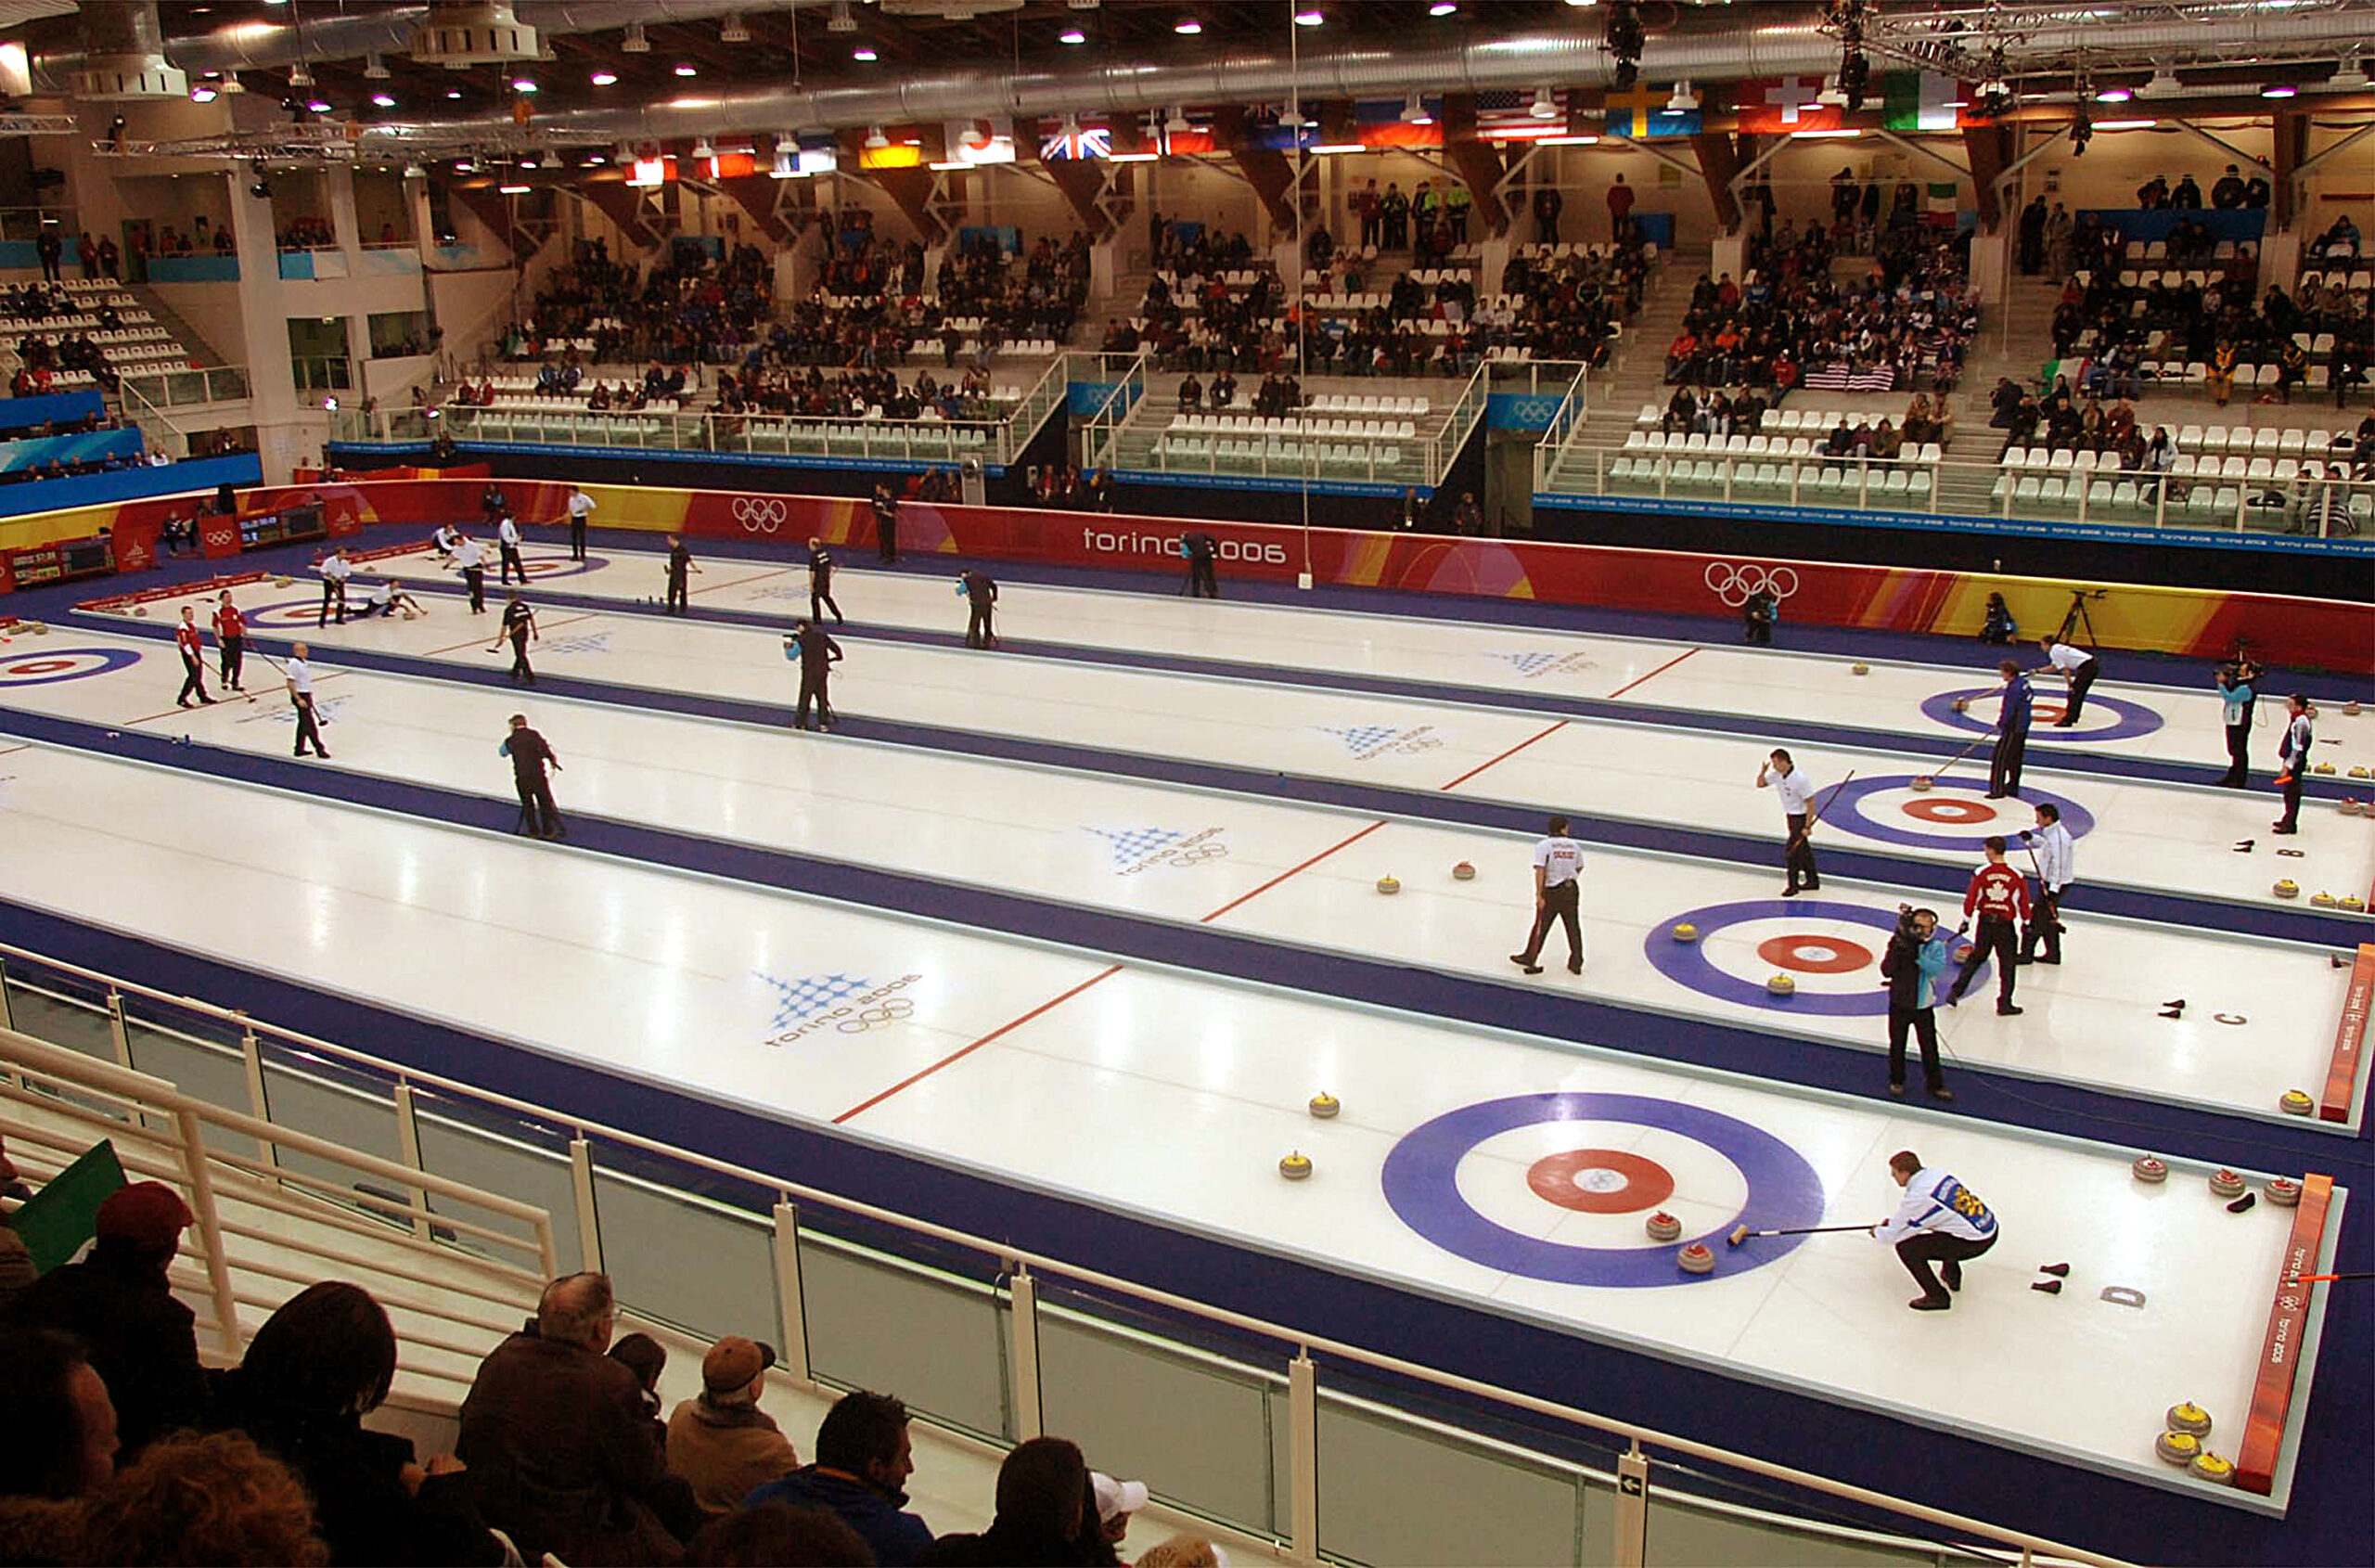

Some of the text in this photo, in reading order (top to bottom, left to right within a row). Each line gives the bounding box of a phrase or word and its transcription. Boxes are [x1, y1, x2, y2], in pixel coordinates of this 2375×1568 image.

[2277, 848, 2305, 858] B
[764, 1007, 854, 1047] torino
[2214, 1012, 2247, 1025] C
[2099, 1286, 2147, 1311] D
